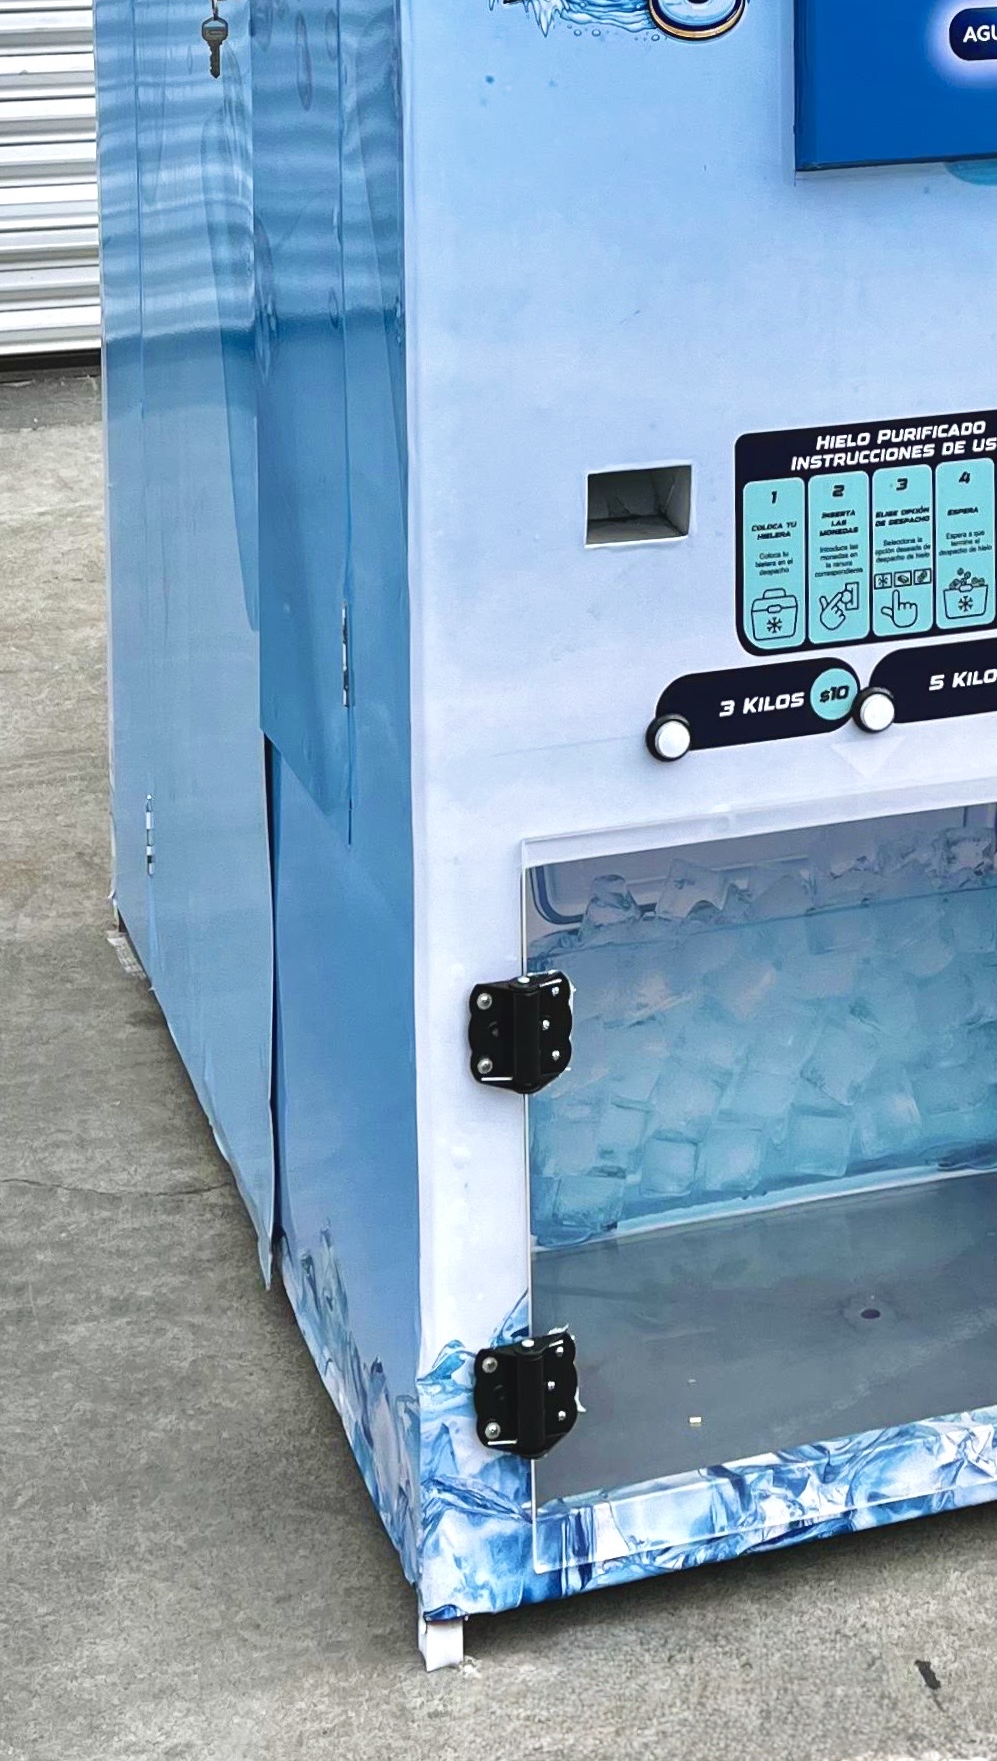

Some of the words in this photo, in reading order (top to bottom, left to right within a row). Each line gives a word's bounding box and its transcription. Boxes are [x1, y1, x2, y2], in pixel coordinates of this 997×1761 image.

[816, 432, 871, 451] HIELO
[876, 420, 987, 444] PURIFICADO
[790, 444, 936, 472] INSTRUCCIONES
[941, 440, 966, 456] DE
[896, 478, 908, 491] 3
[958, 471, 970, 484] 4
[771, 490, 778, 504] 1
[832, 484, 845, 498] 2
[928, 674, 946, 692] 5
[819, 684, 850, 704] $10
[718, 700, 736, 718] 3
[742, 692, 806, 715] KILOS
